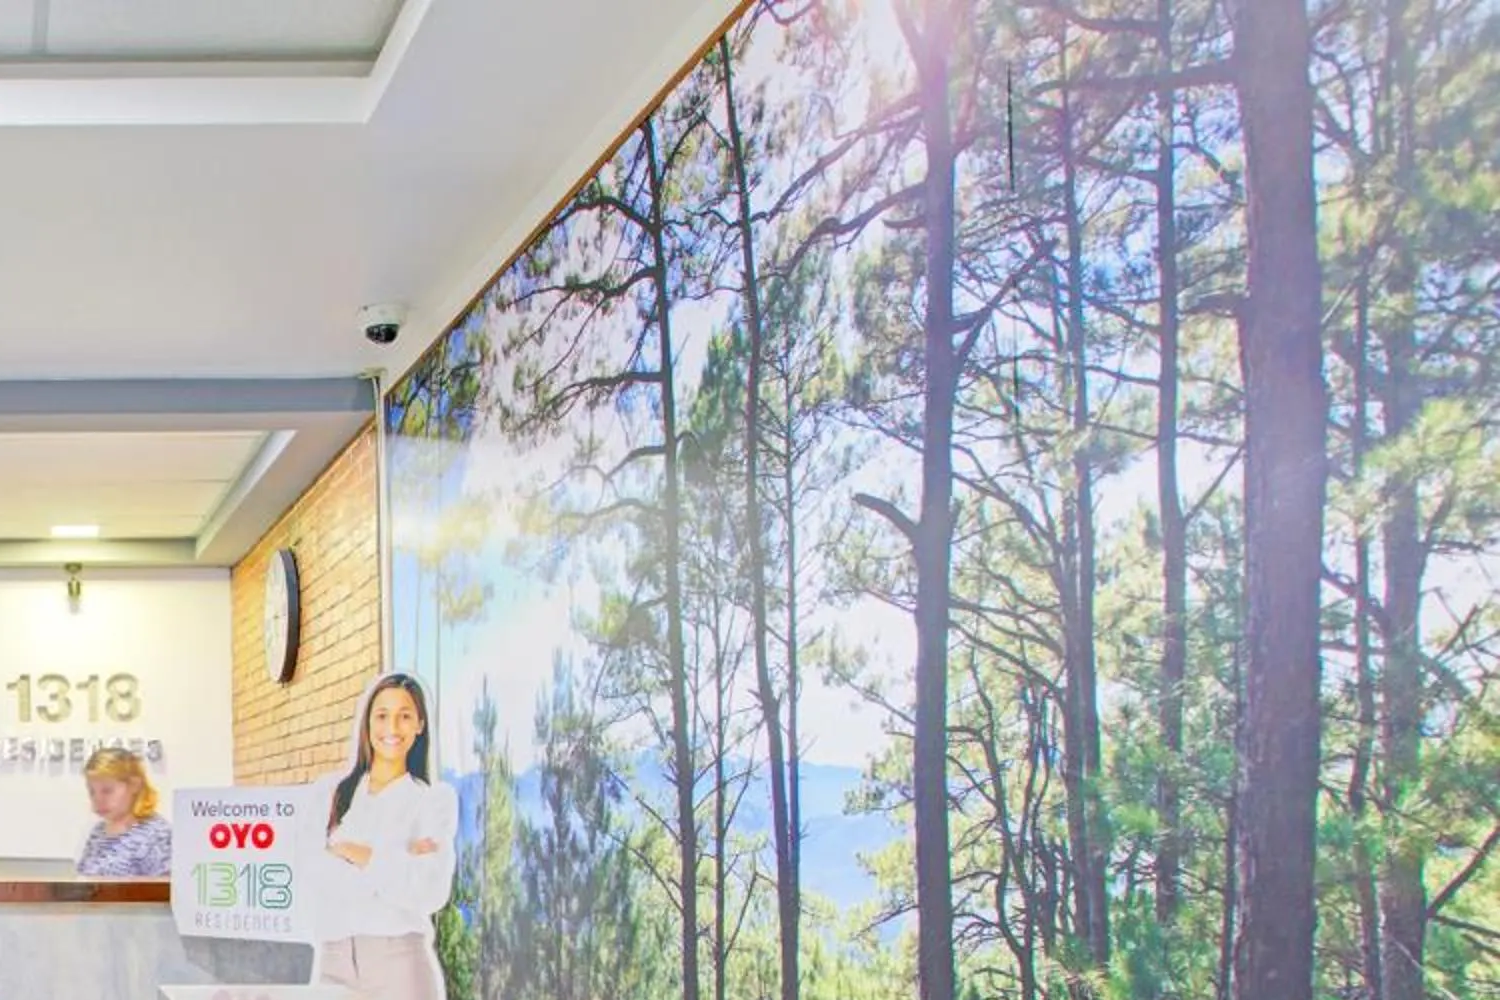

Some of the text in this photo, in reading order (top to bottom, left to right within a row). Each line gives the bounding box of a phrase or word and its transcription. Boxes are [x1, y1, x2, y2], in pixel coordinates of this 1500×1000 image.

[6, 673, 142, 722] 1318
[191, 800, 295, 817] Welcome to
[209, 823, 275, 849] OYO
[191, 862, 293, 909] 1318
[195, 912, 292, 933] RESIDENCES
